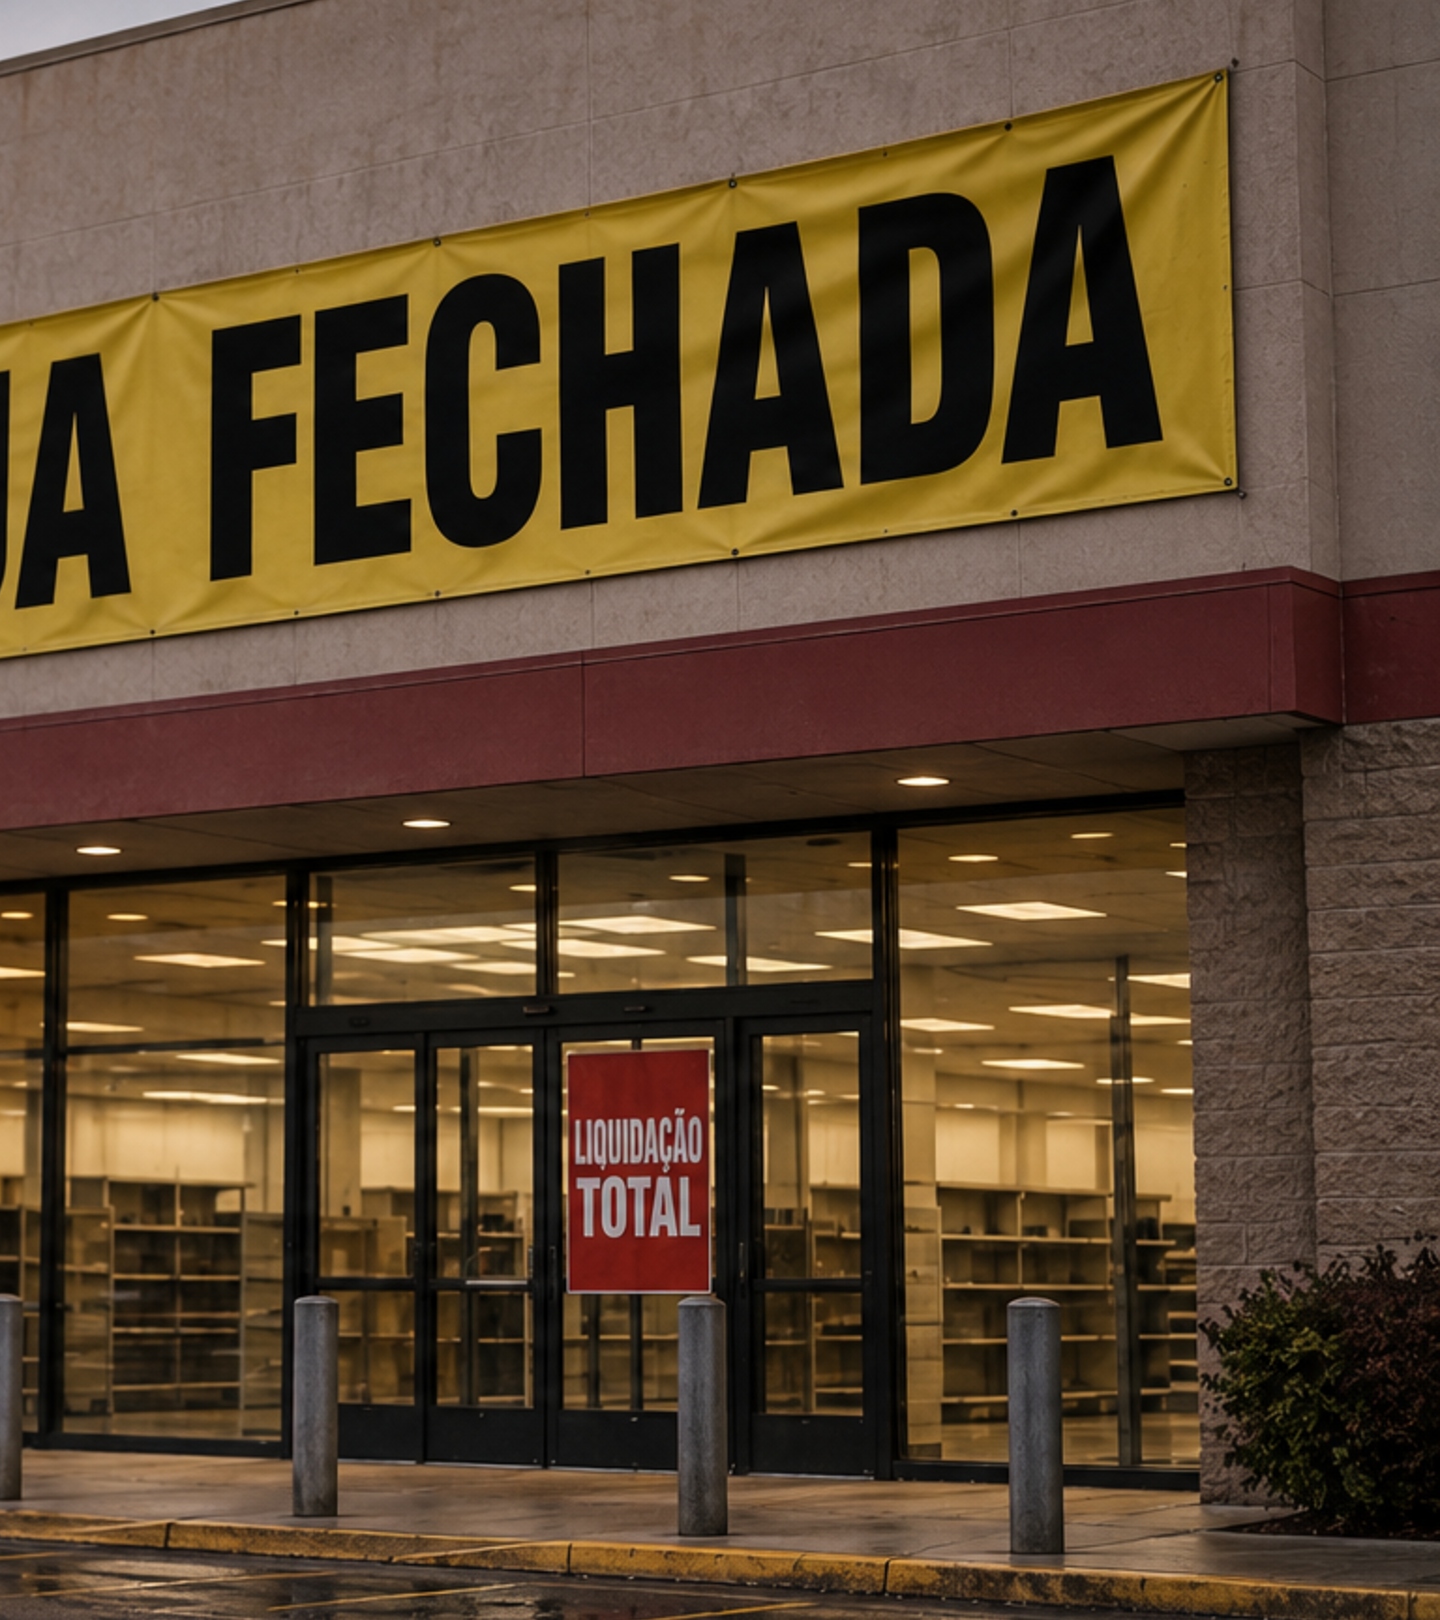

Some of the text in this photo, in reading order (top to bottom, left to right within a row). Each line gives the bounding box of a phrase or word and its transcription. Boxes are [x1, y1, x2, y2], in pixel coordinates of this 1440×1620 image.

[209, 154, 1164, 582] FECHADA
[574, 1108, 703, 1173] LIQUIDAÇÃO
[576, 1175, 702, 1238] TOTAL
